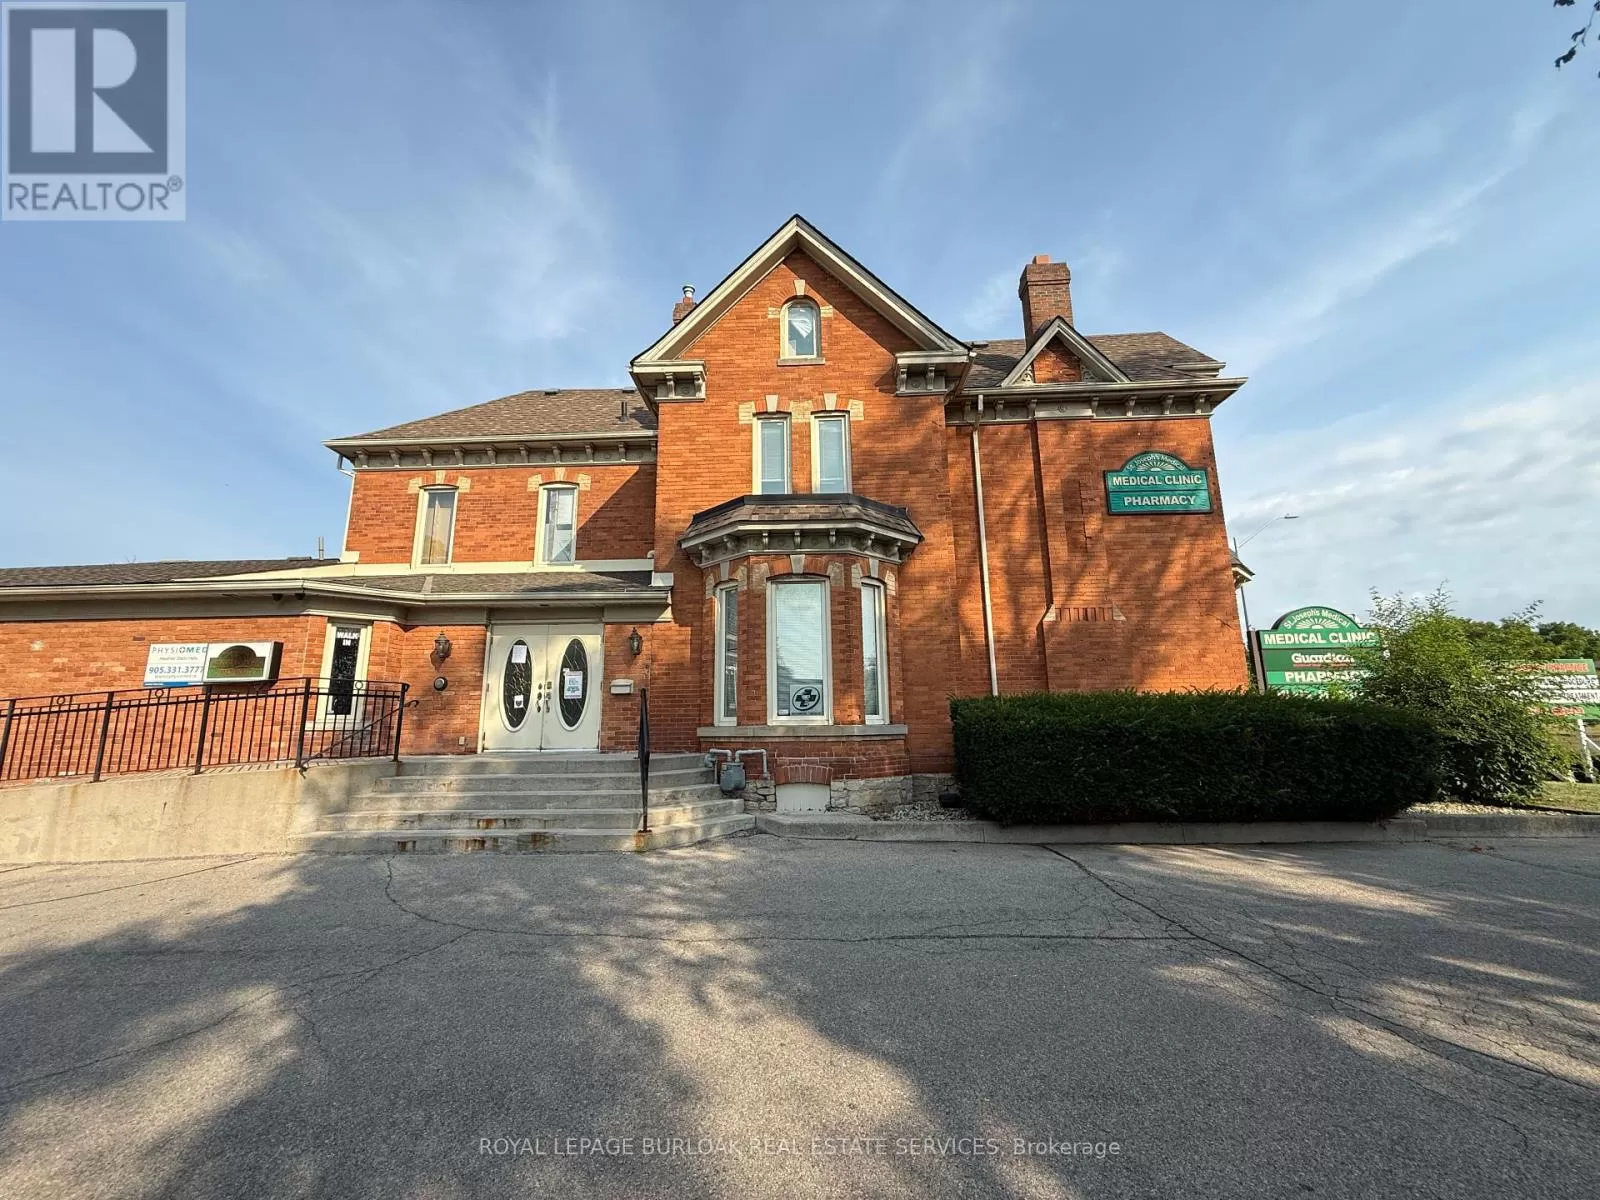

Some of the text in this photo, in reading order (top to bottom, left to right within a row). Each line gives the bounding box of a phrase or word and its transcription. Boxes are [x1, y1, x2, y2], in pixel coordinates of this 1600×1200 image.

[1113, 475, 1202, 486] MEDICAL CLINIC
[1124, 495, 1196, 506] PHARMACY
[1321, 609, 1351, 628] Medical
[342, 639, 352, 647] IN
[1264, 631, 1376, 645] MEDICAL CLINIC
[152, 646, 208, 654] PHYSIOMED
[1291, 652, 1355, 664] Guardian
